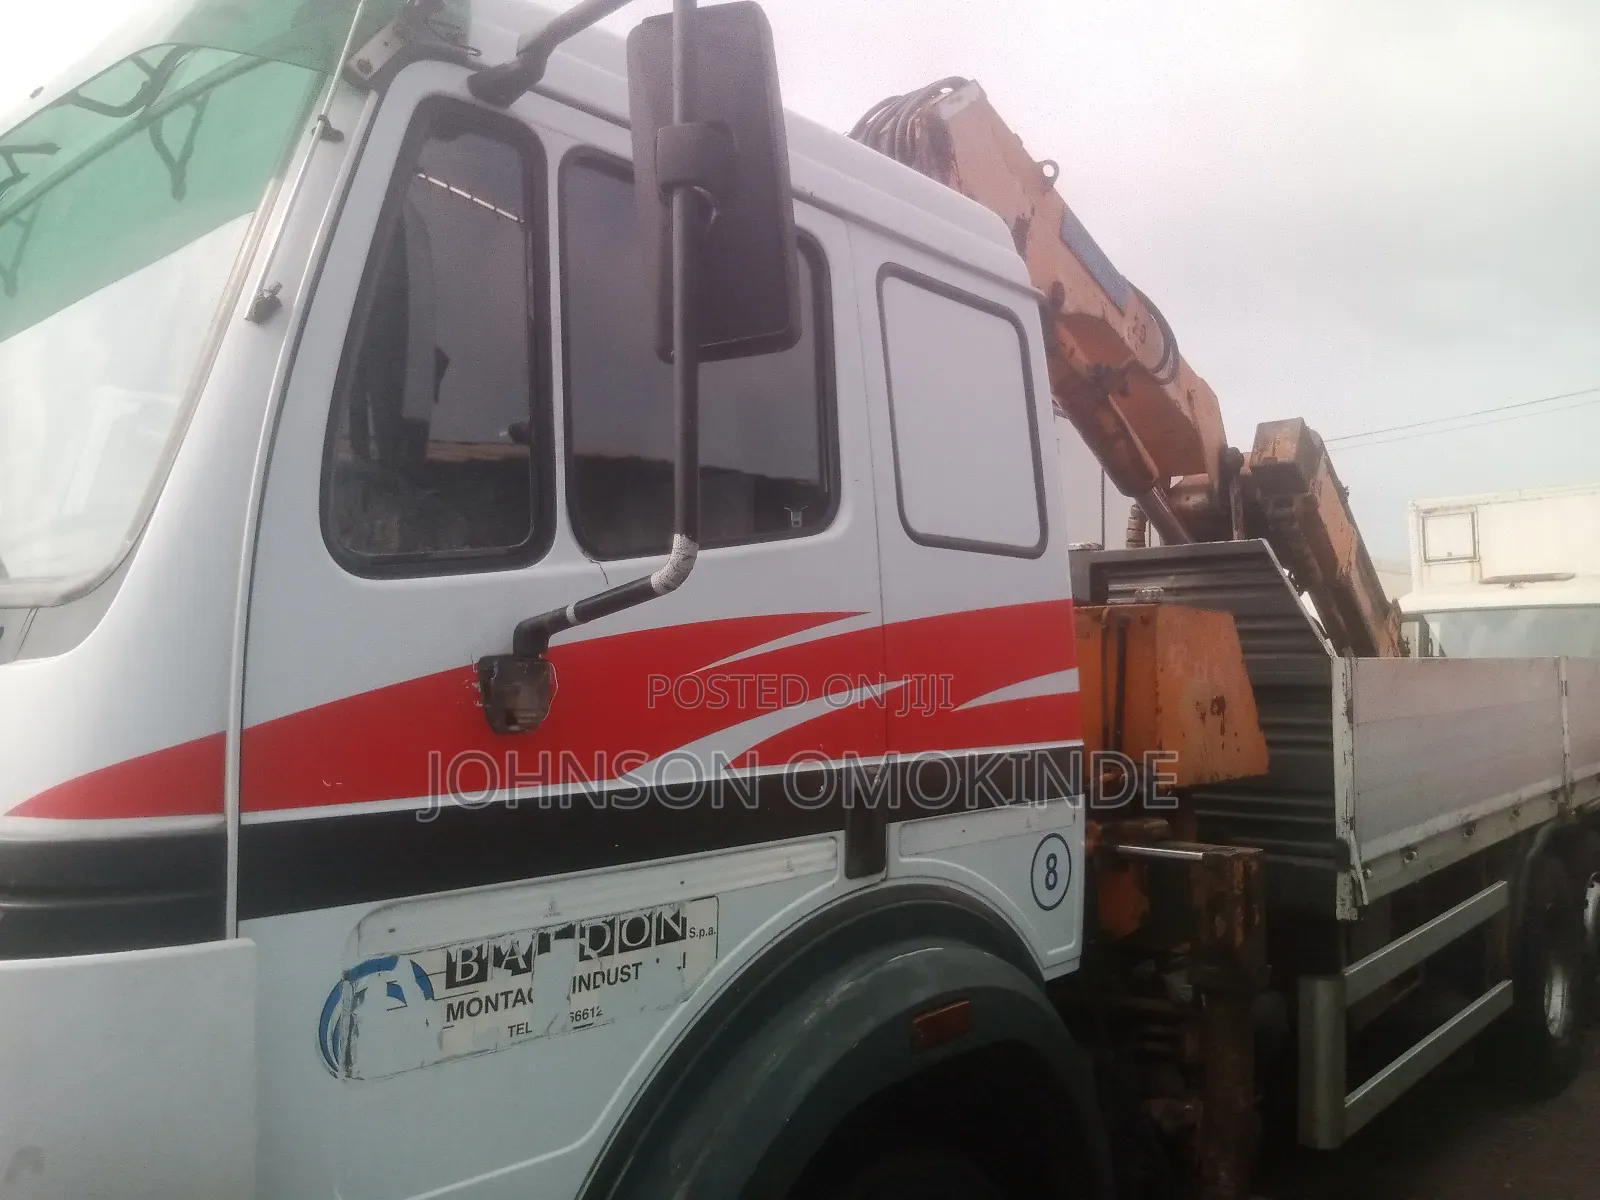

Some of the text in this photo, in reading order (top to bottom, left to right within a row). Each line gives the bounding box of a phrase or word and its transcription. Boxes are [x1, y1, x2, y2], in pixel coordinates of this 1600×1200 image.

[1045, 853, 1058, 890] 8
[453, 907, 685, 983] BADON
[508, 1021, 533, 1037] TEL
